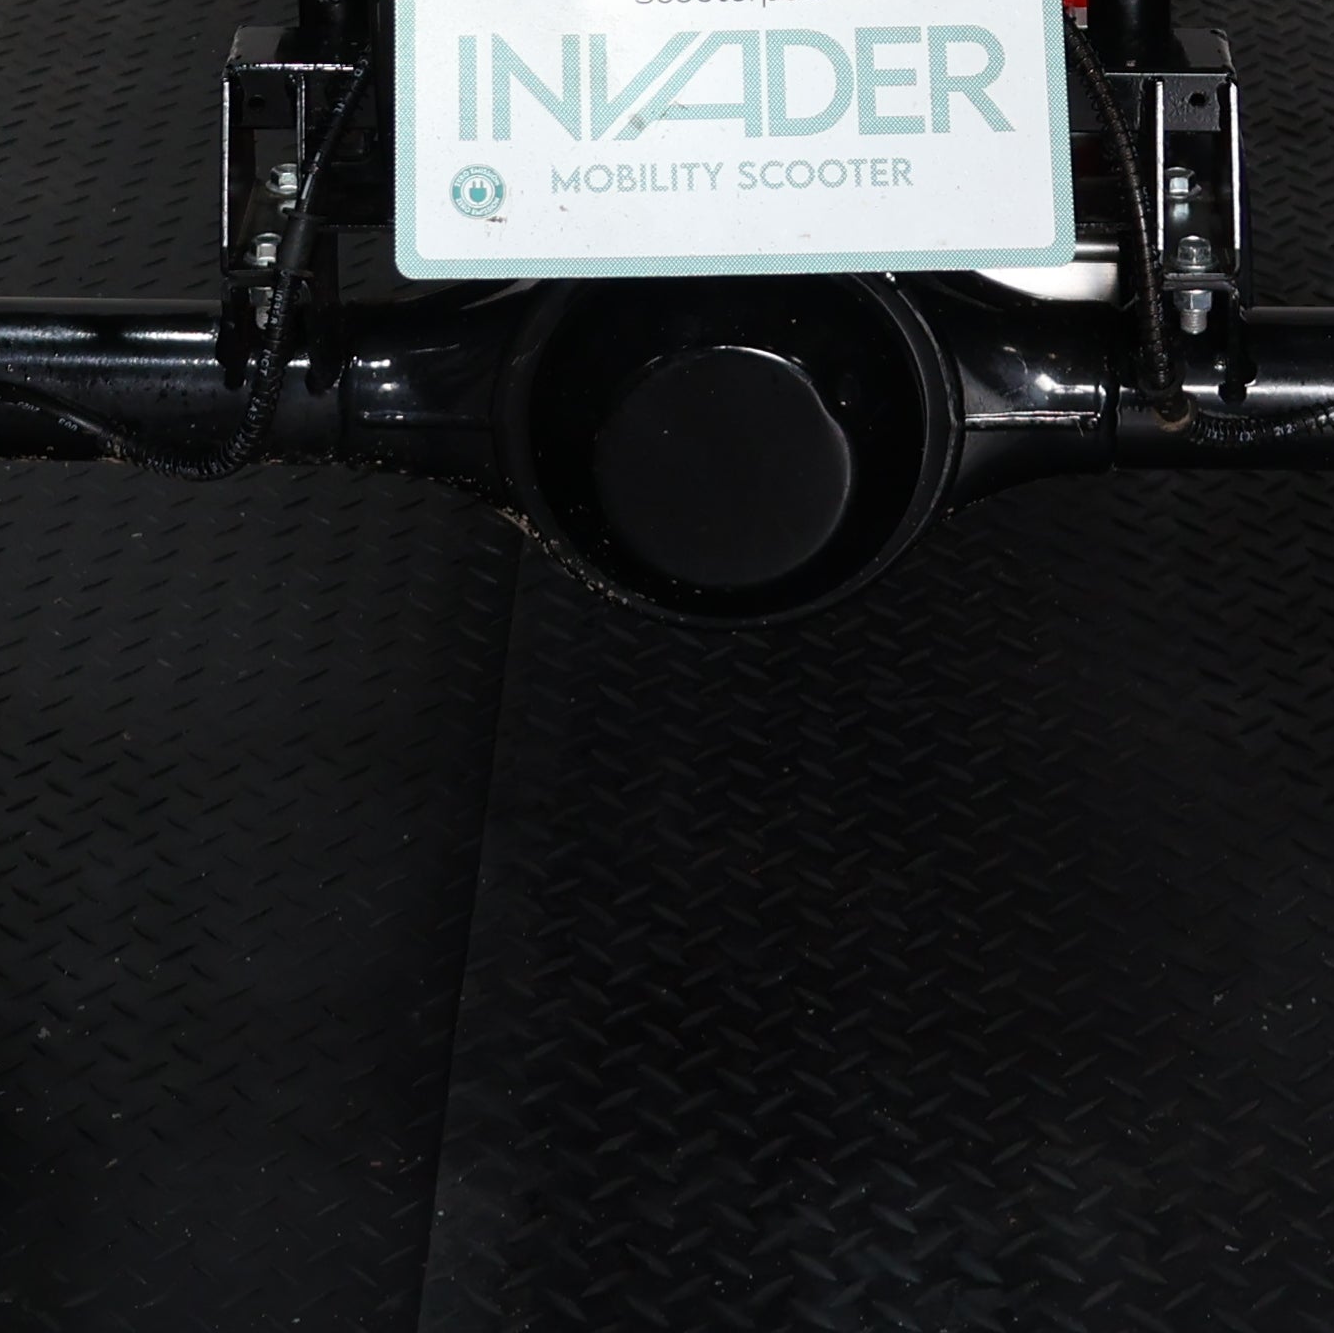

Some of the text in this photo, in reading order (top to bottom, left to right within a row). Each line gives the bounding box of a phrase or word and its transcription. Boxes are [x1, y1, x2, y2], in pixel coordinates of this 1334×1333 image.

[458, 24, 1016, 141] INVADER
[550, 158, 914, 194] MOBILITY SCOOTER
